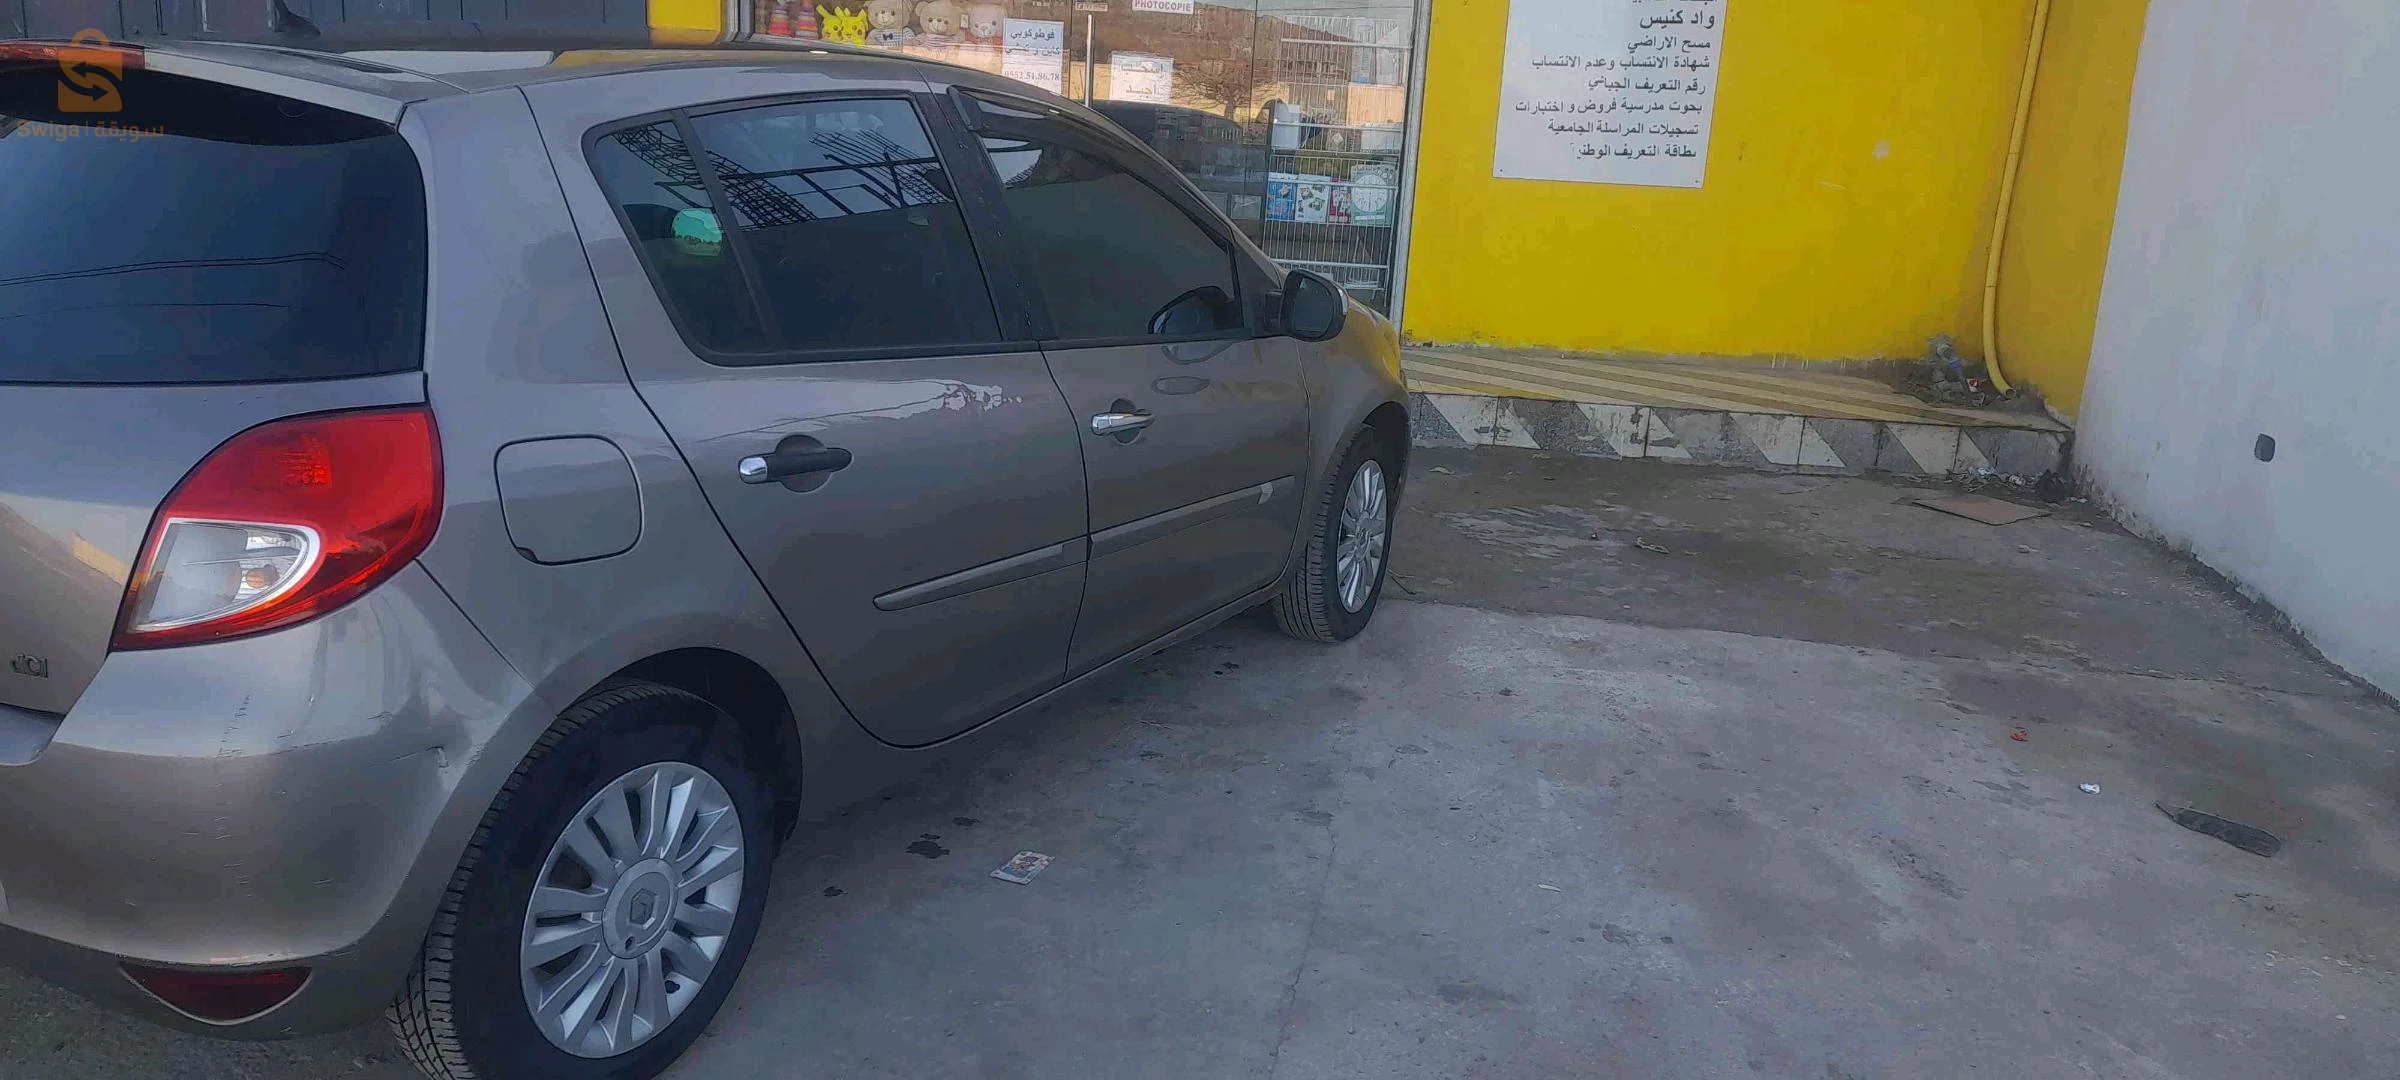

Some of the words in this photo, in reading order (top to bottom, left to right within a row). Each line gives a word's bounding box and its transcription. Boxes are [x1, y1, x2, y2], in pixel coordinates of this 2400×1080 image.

[1134, 0, 1192, 12] PHOTOCOPIE
[1640, 9, 1684, 29] كنيس
[1690, 10, 1715, 29] واد
[1627, 36, 1677, 54] الاراضي
[1681, 37, 1711, 53] مسح
[1532, 55, 1581, 70] الانتساب
[1585, 58, 1615, 72] وعدم
[1620, 55, 1669, 70] الانتساب
[1673, 56, 1711, 72] شهادة
[1635, 77, 1681, 94] التعريف
[1685, 77, 1706, 95] رقم
[1515, 100, 1564, 115] اختبارات
[1567, 104, 1575, 114] و
[1577, 98, 1617, 114] فروض
[1621, 98, 1665, 115] مدرسية
[1548, 119, 1594, 136] الجامعية
[1596, 120, 1644, 136] المراسلة
[1648, 123, 1699, 138] تسجيلات
[1570, 142, 1611, 160] الوطني
[1614, 143, 1660, 160] التعريف
[1665, 142, 1697, 158] بطاقة
